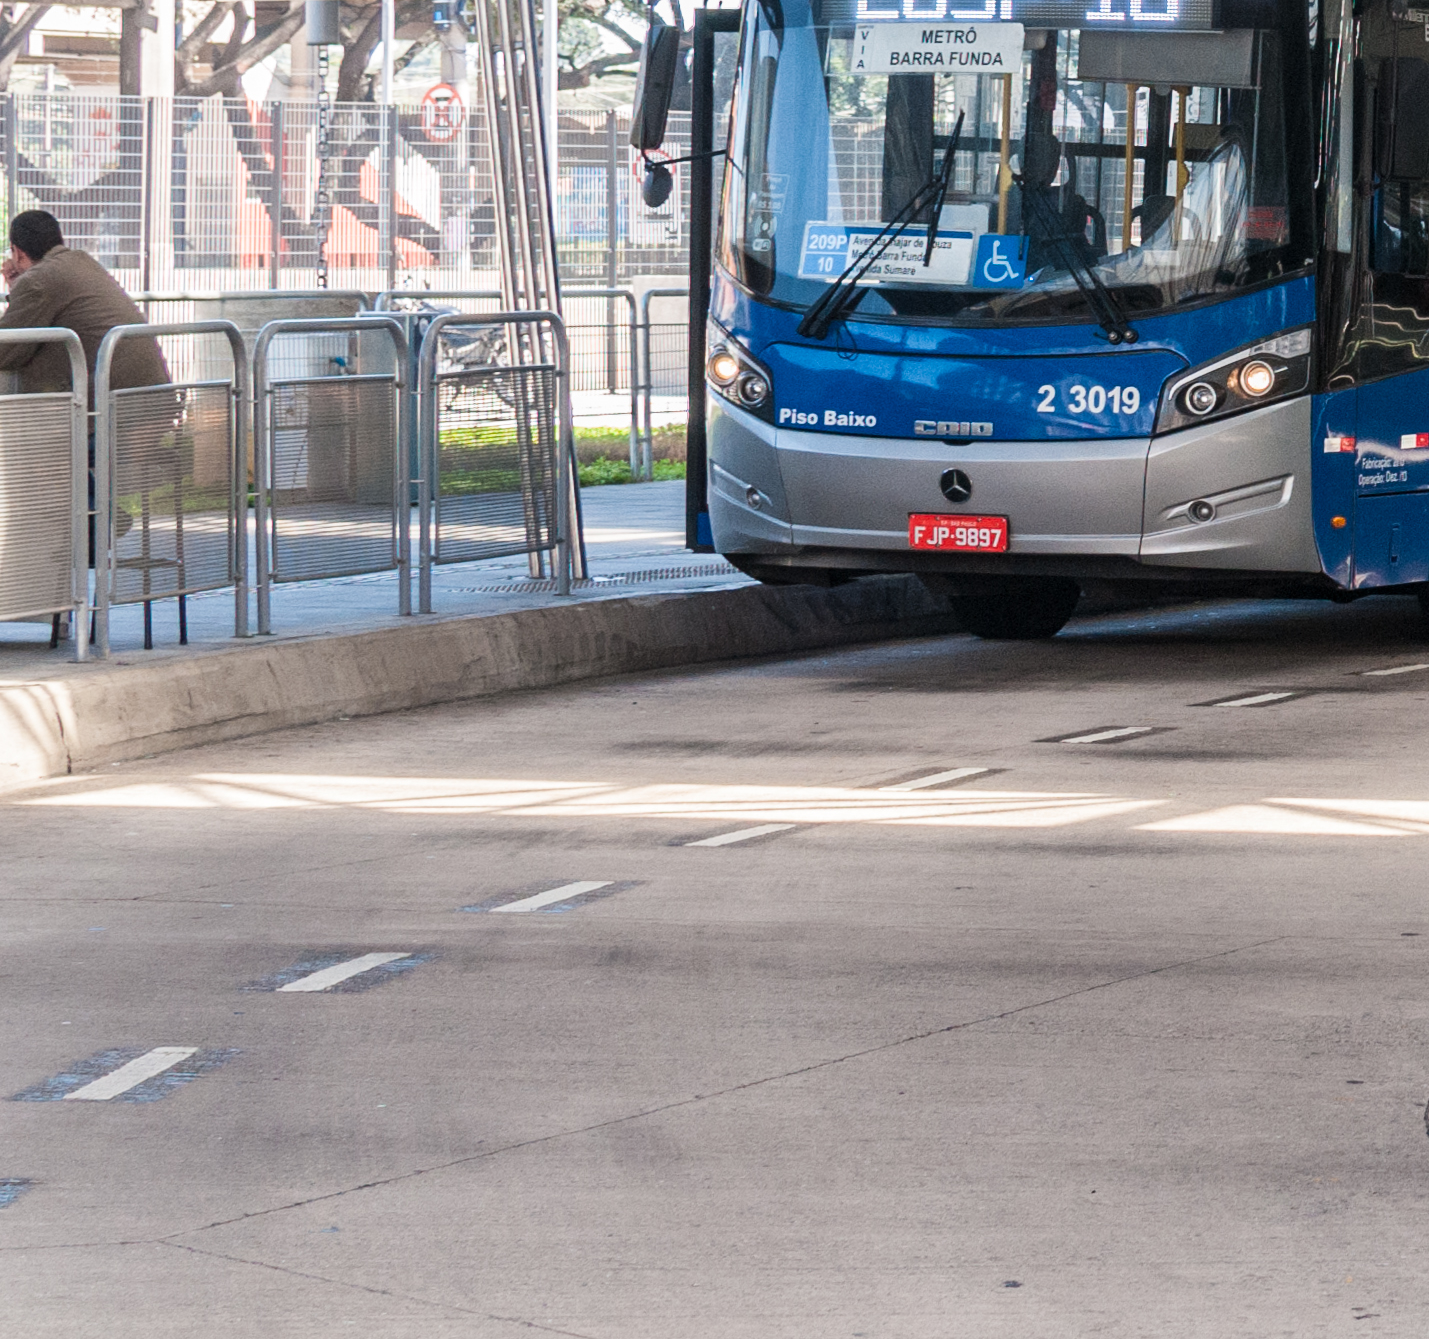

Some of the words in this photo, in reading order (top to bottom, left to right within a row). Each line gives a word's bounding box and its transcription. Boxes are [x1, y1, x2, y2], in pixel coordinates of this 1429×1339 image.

[920, 26, 978, 44] METRÔ
[889, 51, 945, 66] BARRA
[949, 51, 1004, 66] FUNDA
[808, 234, 848, 250] 209P
[818, 257, 834, 272] 10
[1036, 384, 1056, 413] 2
[1068, 385, 1141, 415] 3019
[779, 408, 818, 426] Piso
[823, 410, 877, 428] Baixo
[914, 419, 994, 436] CAIO
